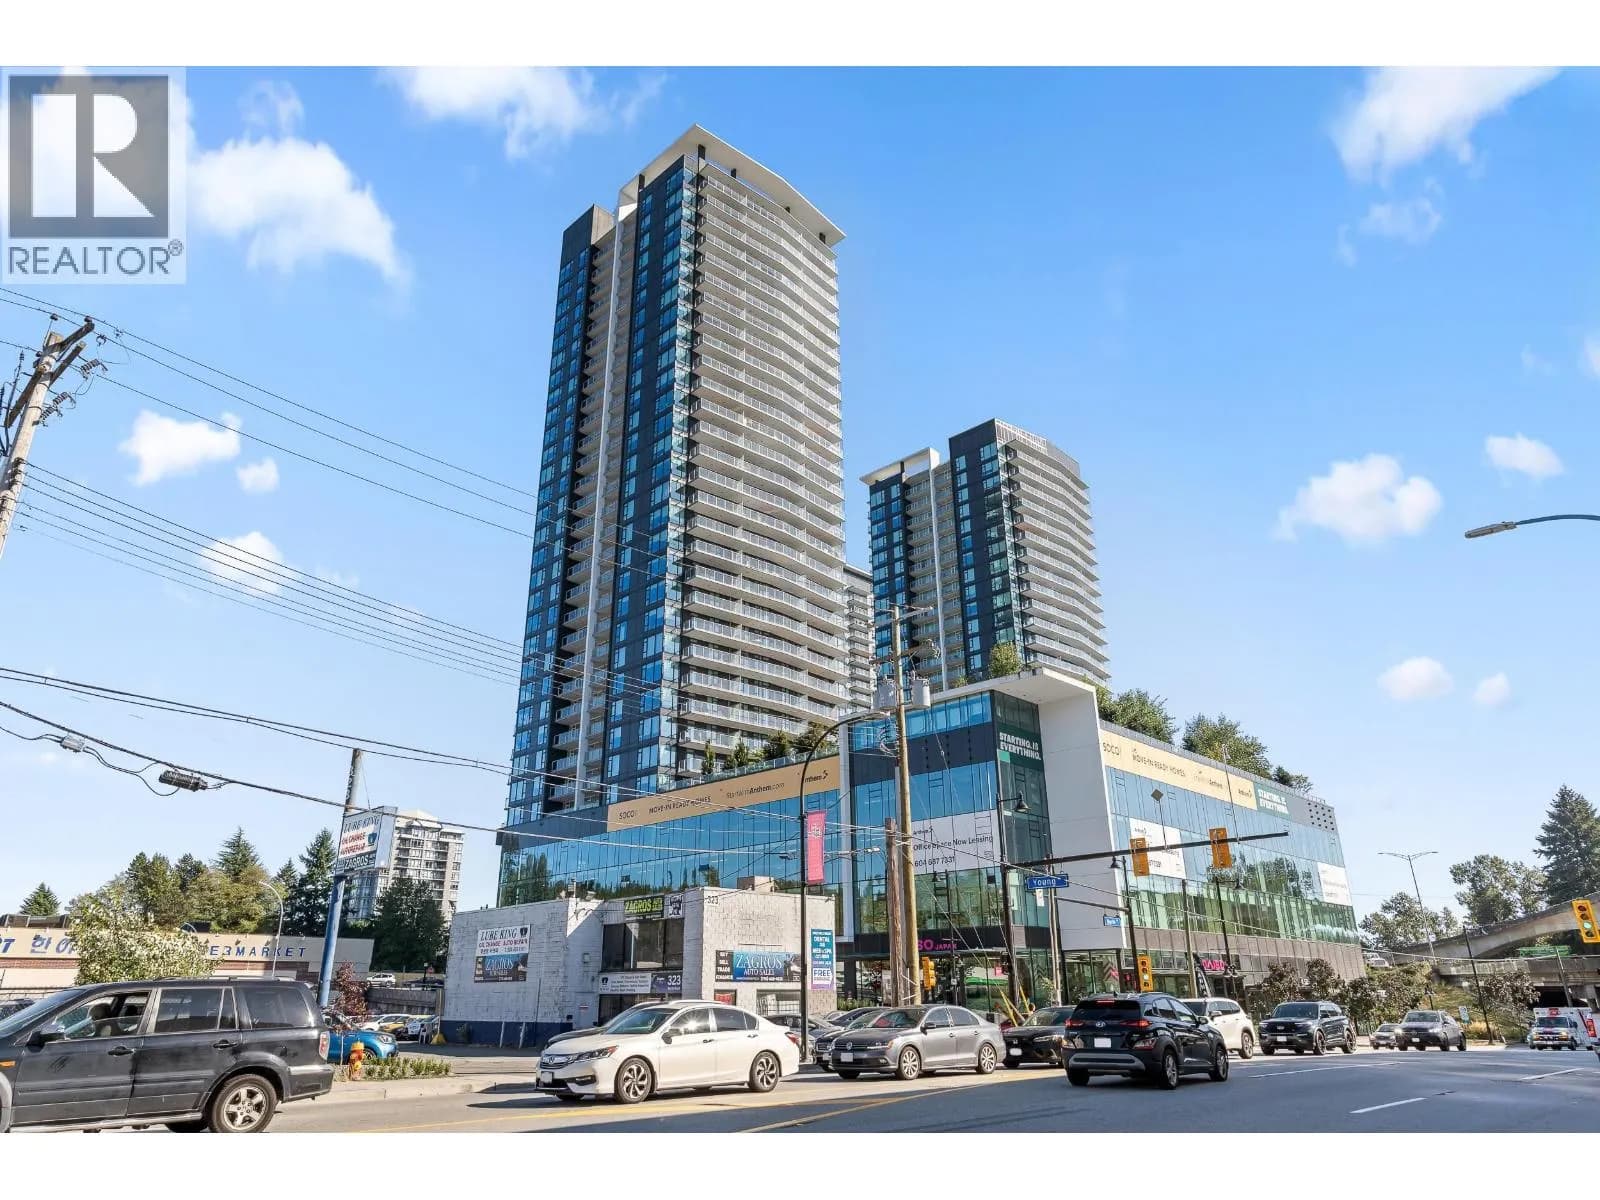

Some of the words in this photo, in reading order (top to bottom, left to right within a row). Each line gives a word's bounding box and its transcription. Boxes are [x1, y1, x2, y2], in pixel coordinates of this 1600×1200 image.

[913, 843, 931, 851] Office
[953, 838, 967, 846] Now
[968, 835, 993, 844] Leasing
[1033, 879, 1056, 887] Young
[624, 898, 652, 913] ZAGROS
[480, 930, 498, 941] LUBE
[500, 928, 517, 940] KING
[485, 957, 514, 971] ZAGROS
[735, 953, 783, 969] ZAGROS
[743, 968, 758, 976] AUTO
[759, 968, 775, 976] SALES
[813, 969, 831, 977] FREE
[667, 975, 681, 986] 323
